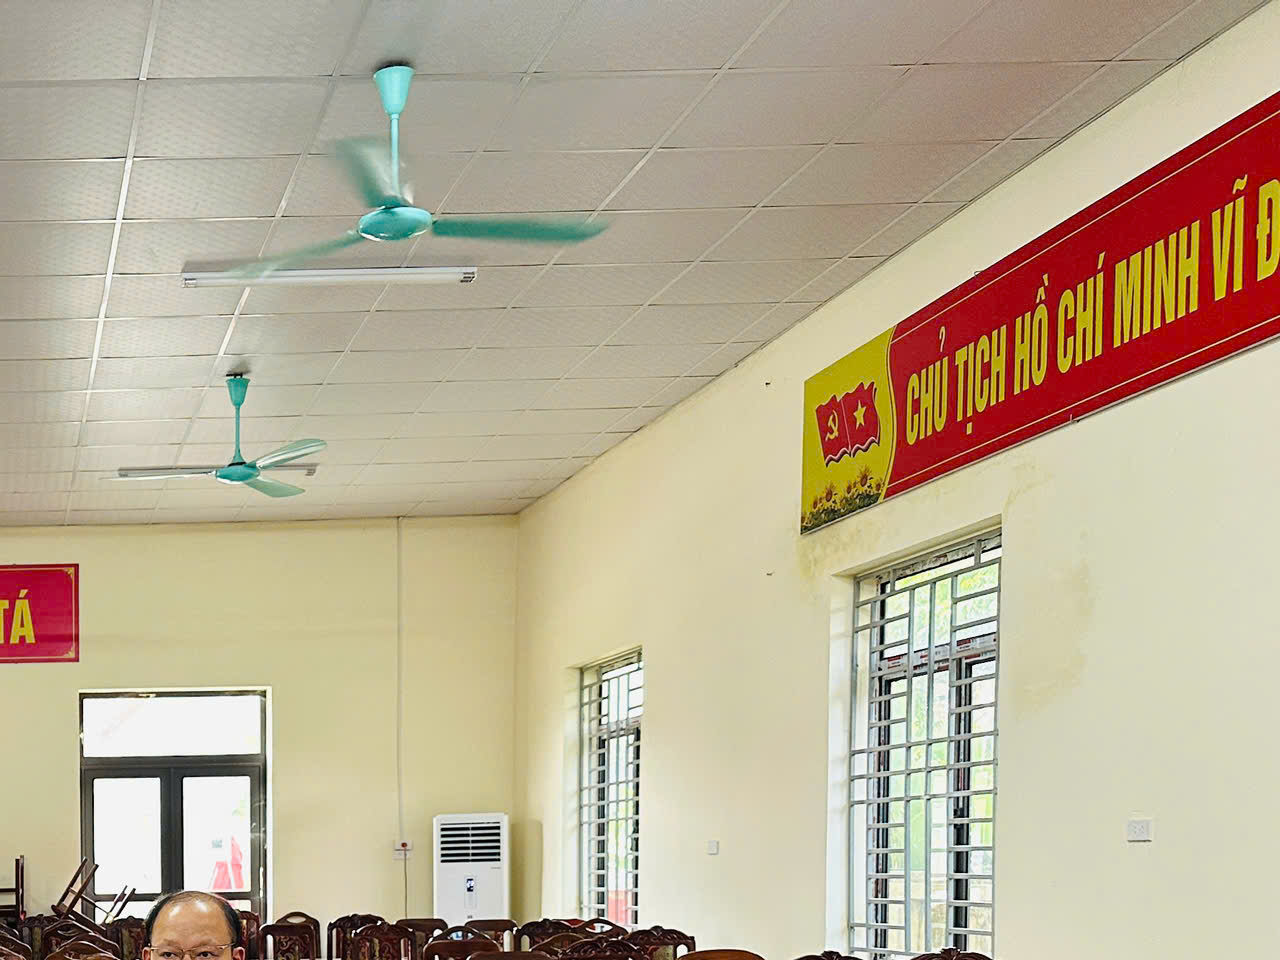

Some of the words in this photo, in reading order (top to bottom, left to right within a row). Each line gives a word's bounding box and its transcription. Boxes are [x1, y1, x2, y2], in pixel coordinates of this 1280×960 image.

[905, 325, 949, 446] CHỦ
[955, 324, 1007, 435] TỊCH
[1014, 273, 1049, 396] HỒ
[1057, 252, 1106, 374] CHÍ
[1113, 219, 1200, 349] MINH
[1211, 173, 1248, 302] VĨ
